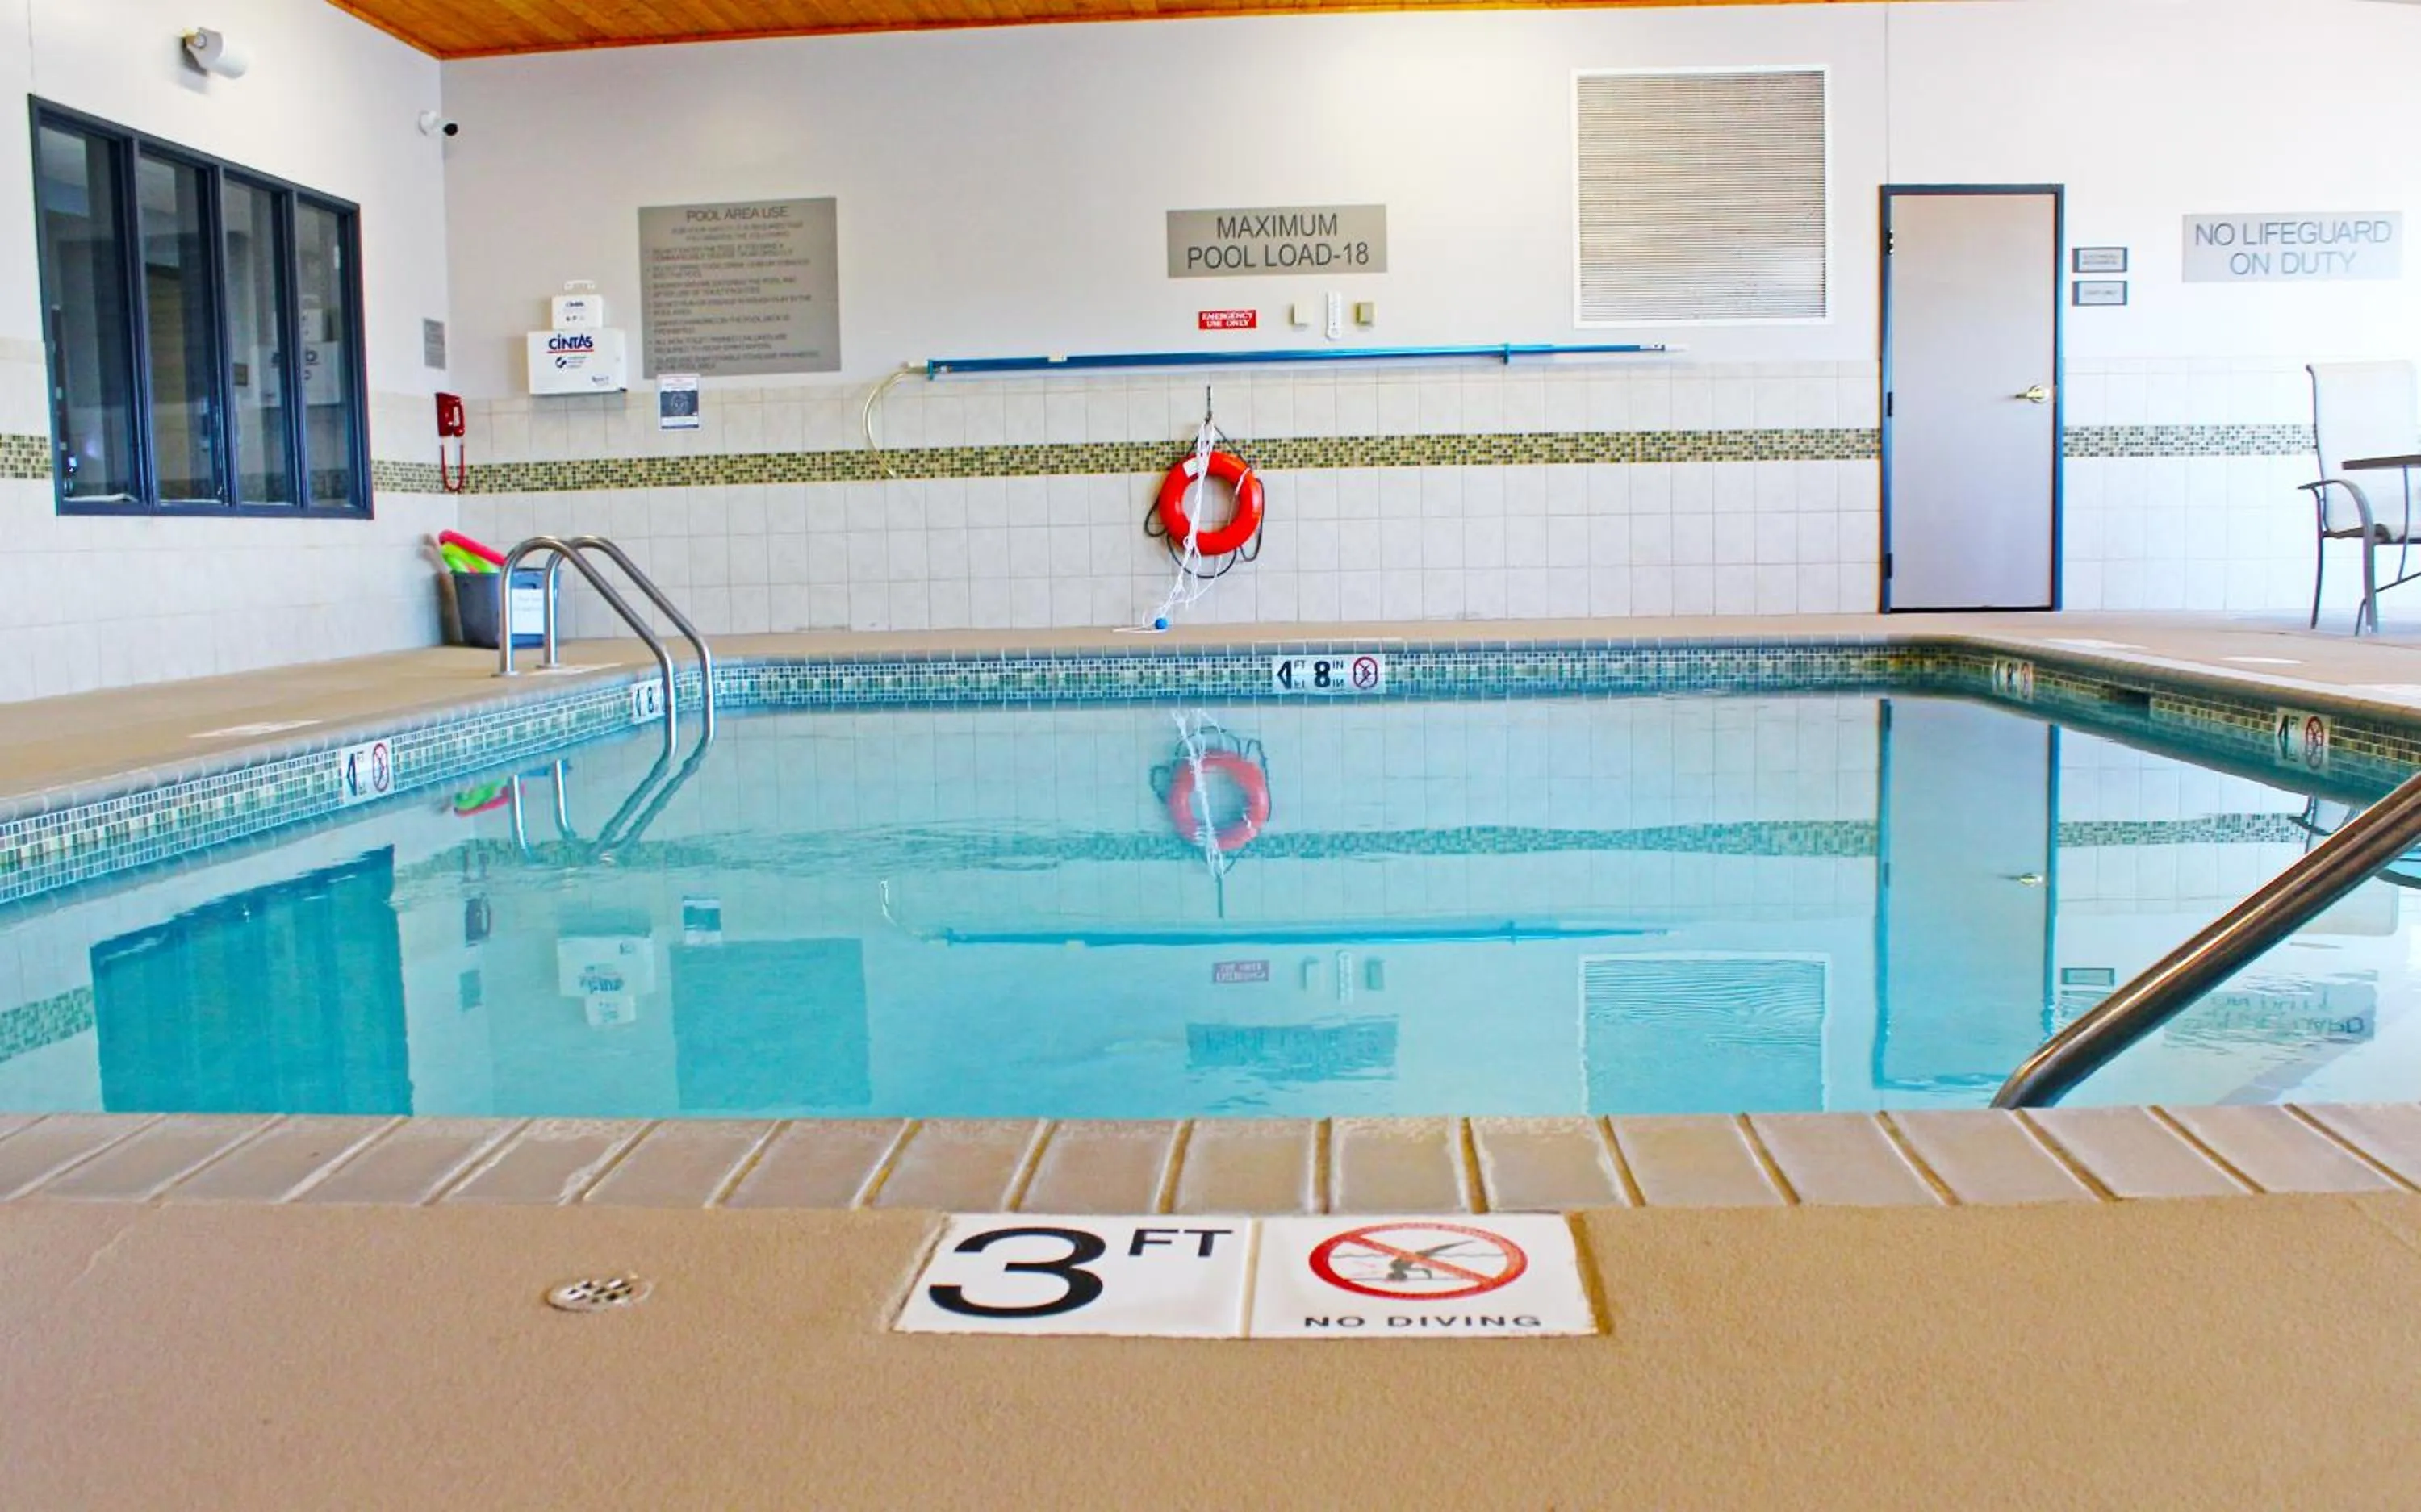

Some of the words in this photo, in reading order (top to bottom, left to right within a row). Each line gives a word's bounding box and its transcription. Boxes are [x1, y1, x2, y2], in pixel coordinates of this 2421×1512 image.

[687, 210, 721, 223] POOL
[724, 207, 759, 220] AREA
[762, 205, 790, 219] USE
[1216, 213, 1337, 239] MAXIMUM
[2195, 222, 2235, 246] NO
[2243, 220, 2392, 246] LIFEGUARD
[1187, 244, 1256, 269] POOL
[1265, 242, 1369, 267] LOAD-18
[2229, 252, 2270, 276] ON
[2281, 251, 2357, 275] DUTY
[928, 1227, 1106, 1318] 3
[1128, 1229, 1233, 1257] FT
[1305, 1316, 1365, 1327] NO
[1387, 1315, 1542, 1327] DIVING
